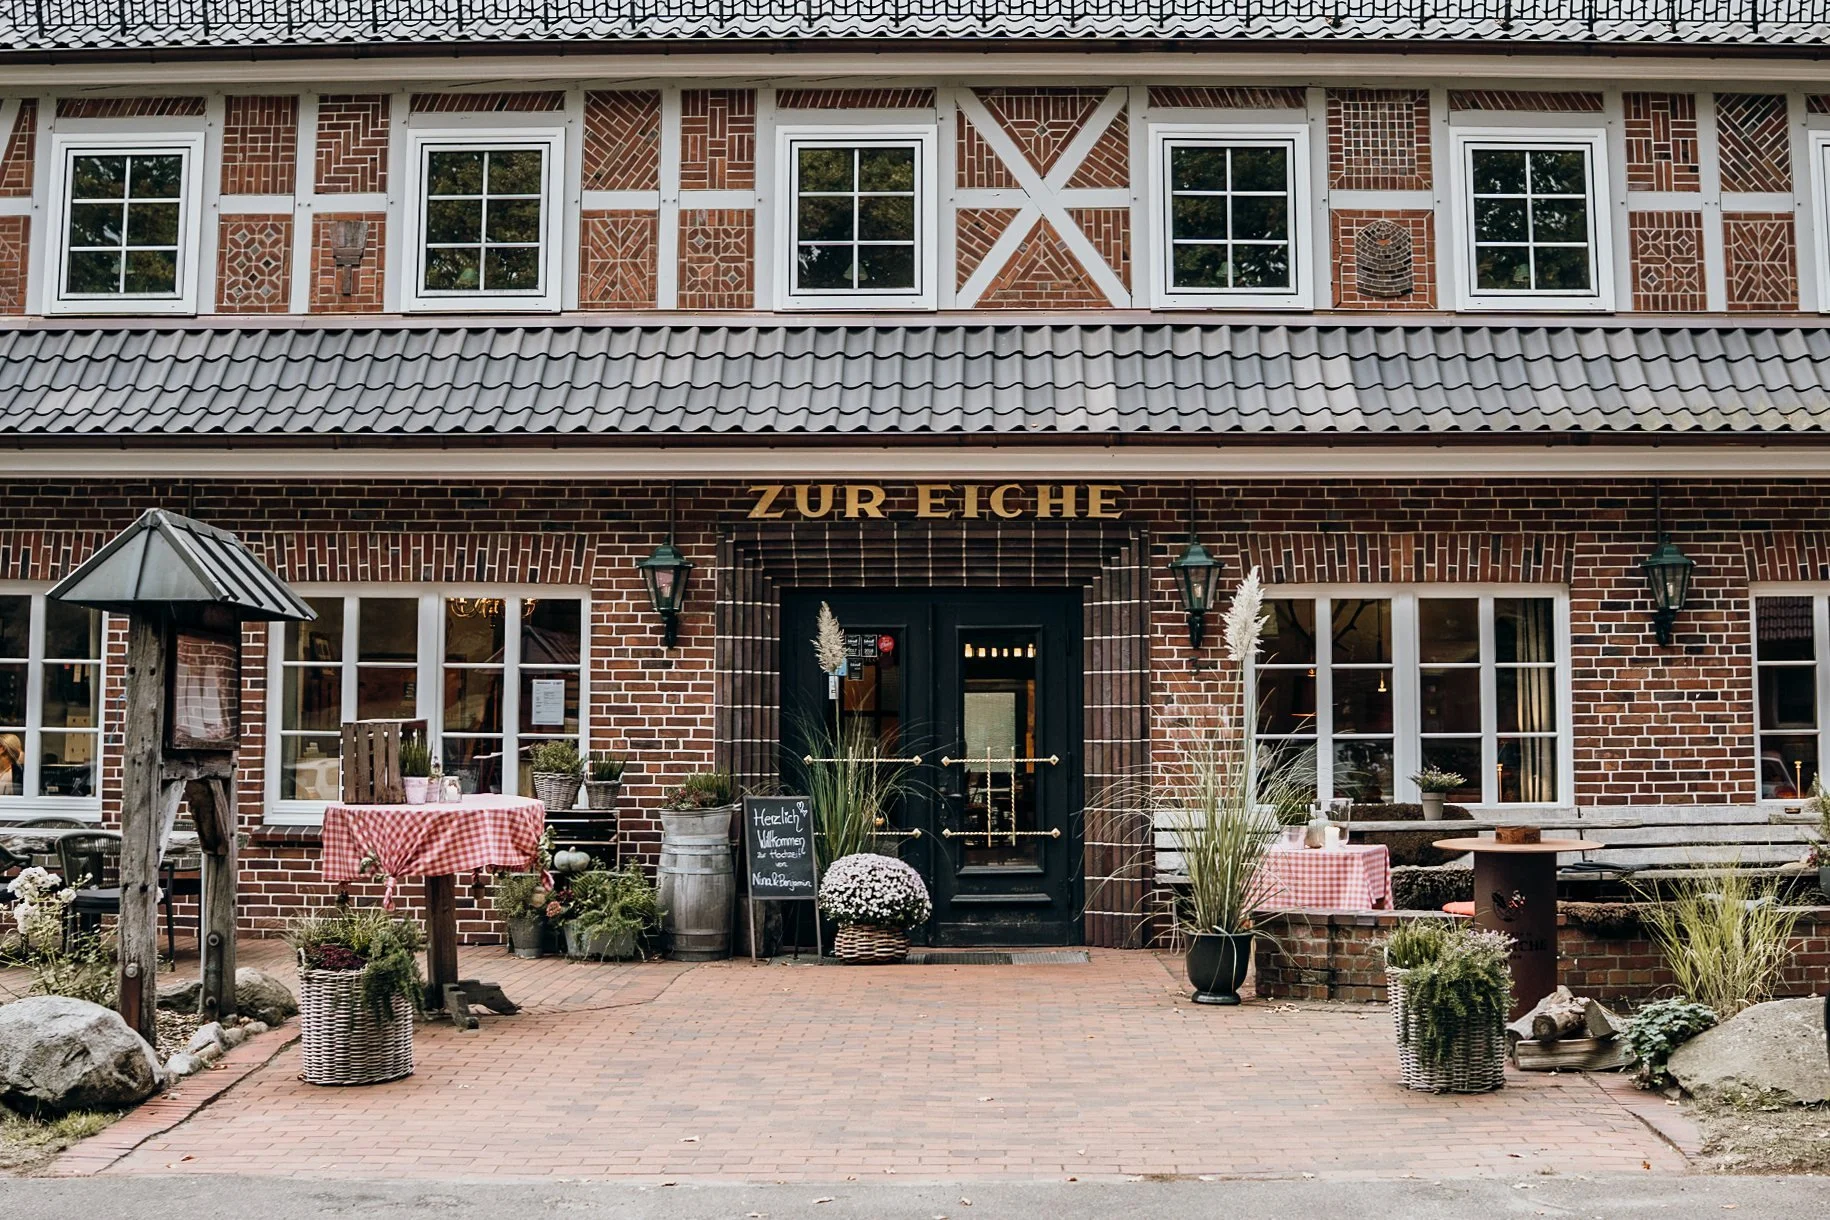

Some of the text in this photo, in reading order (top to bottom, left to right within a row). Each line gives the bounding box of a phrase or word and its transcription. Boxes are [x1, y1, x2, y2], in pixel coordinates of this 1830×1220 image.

[746, 483, 1126, 519] ZUR EICHE
[753, 806, 803, 832] Herzlich
[757, 829, 806, 854] Willkommen
